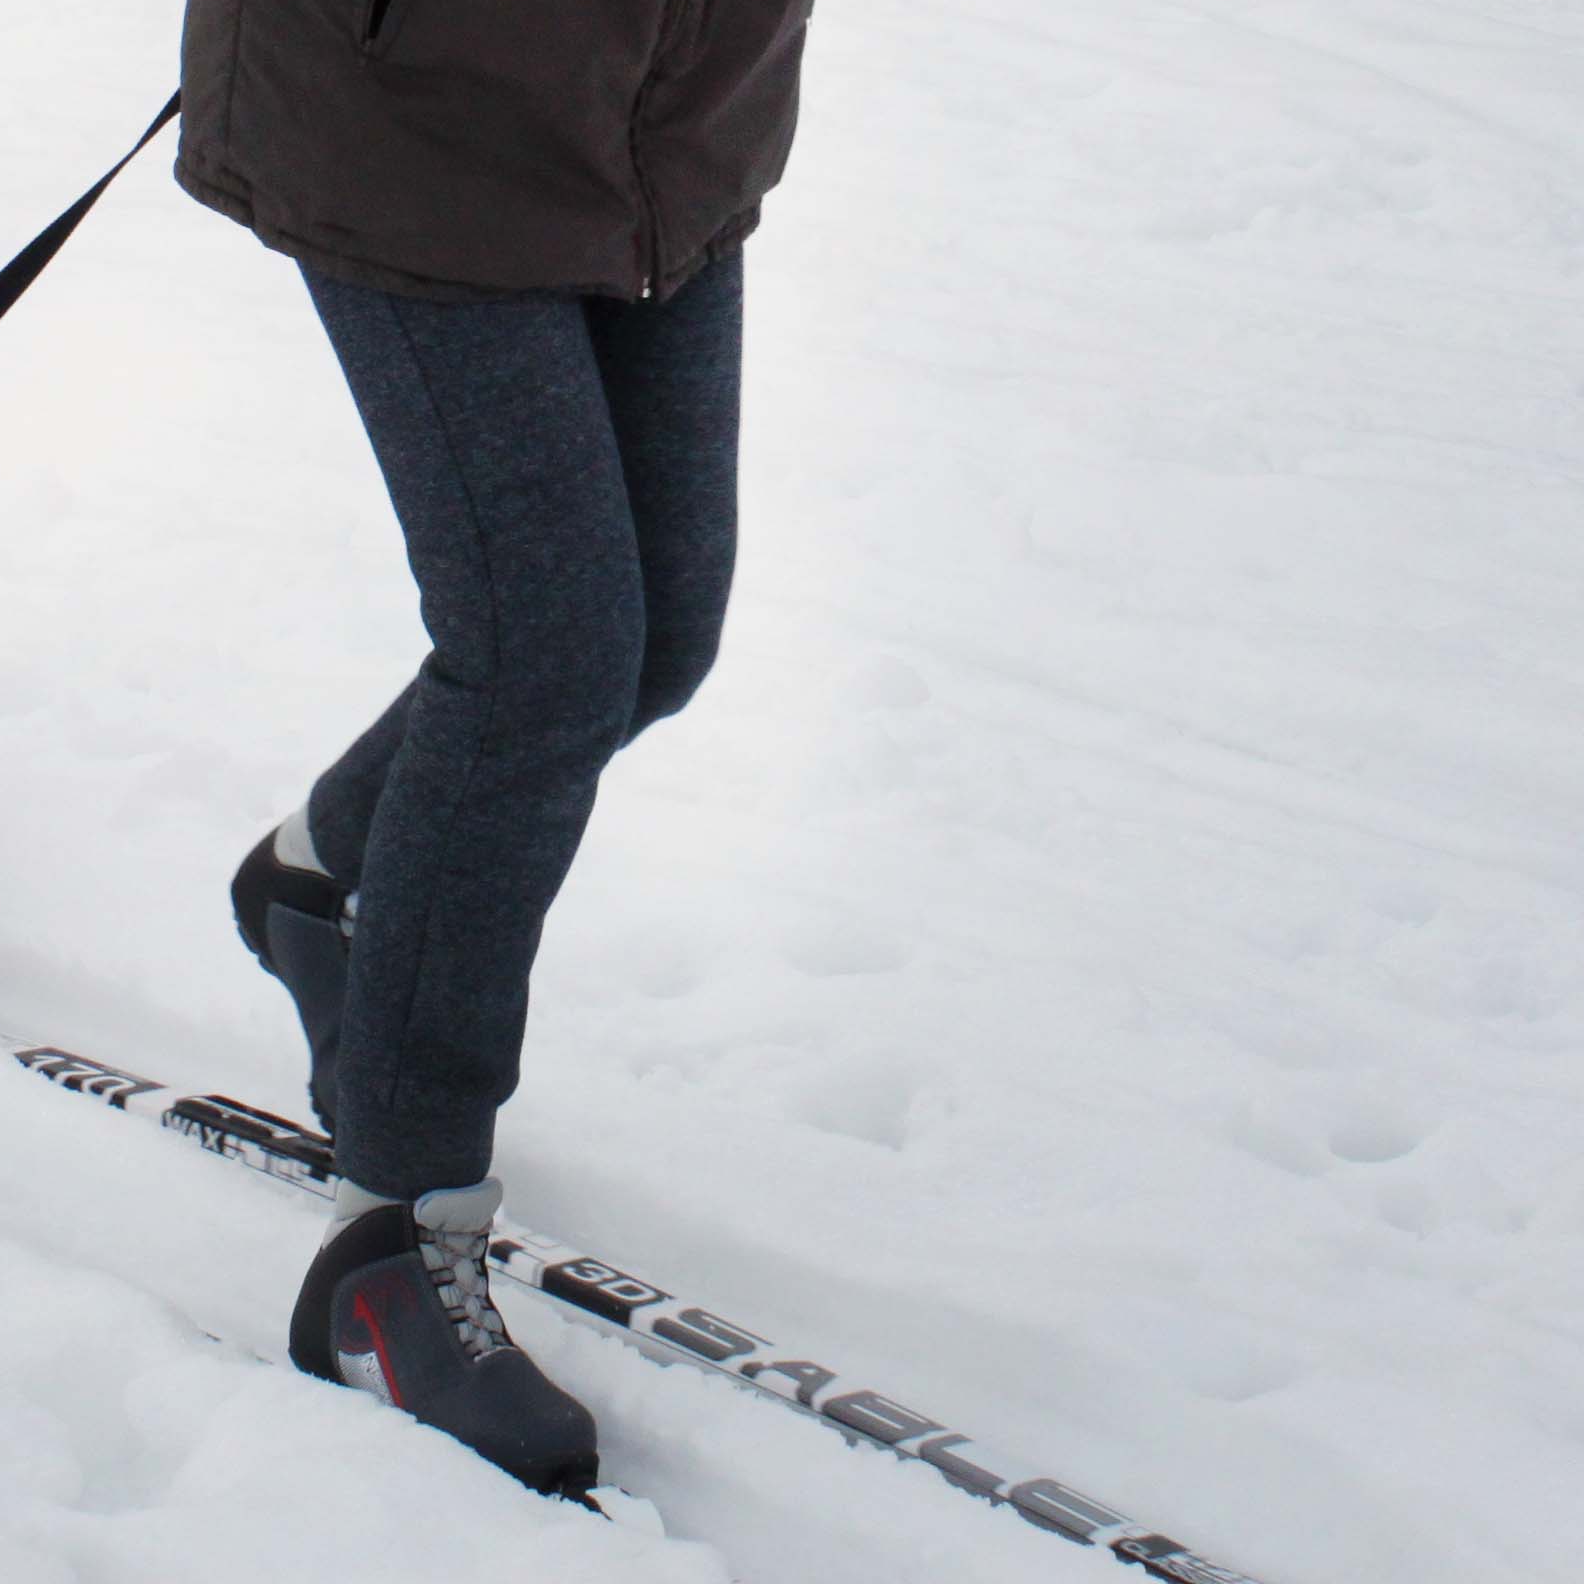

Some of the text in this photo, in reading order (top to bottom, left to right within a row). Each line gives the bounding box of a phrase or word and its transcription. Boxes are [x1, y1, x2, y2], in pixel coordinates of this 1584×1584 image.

[27, 1054, 137, 1106] 170
[561, 1261, 658, 1302] 3D
[652, 1307, 1135, 1545] SABLE
